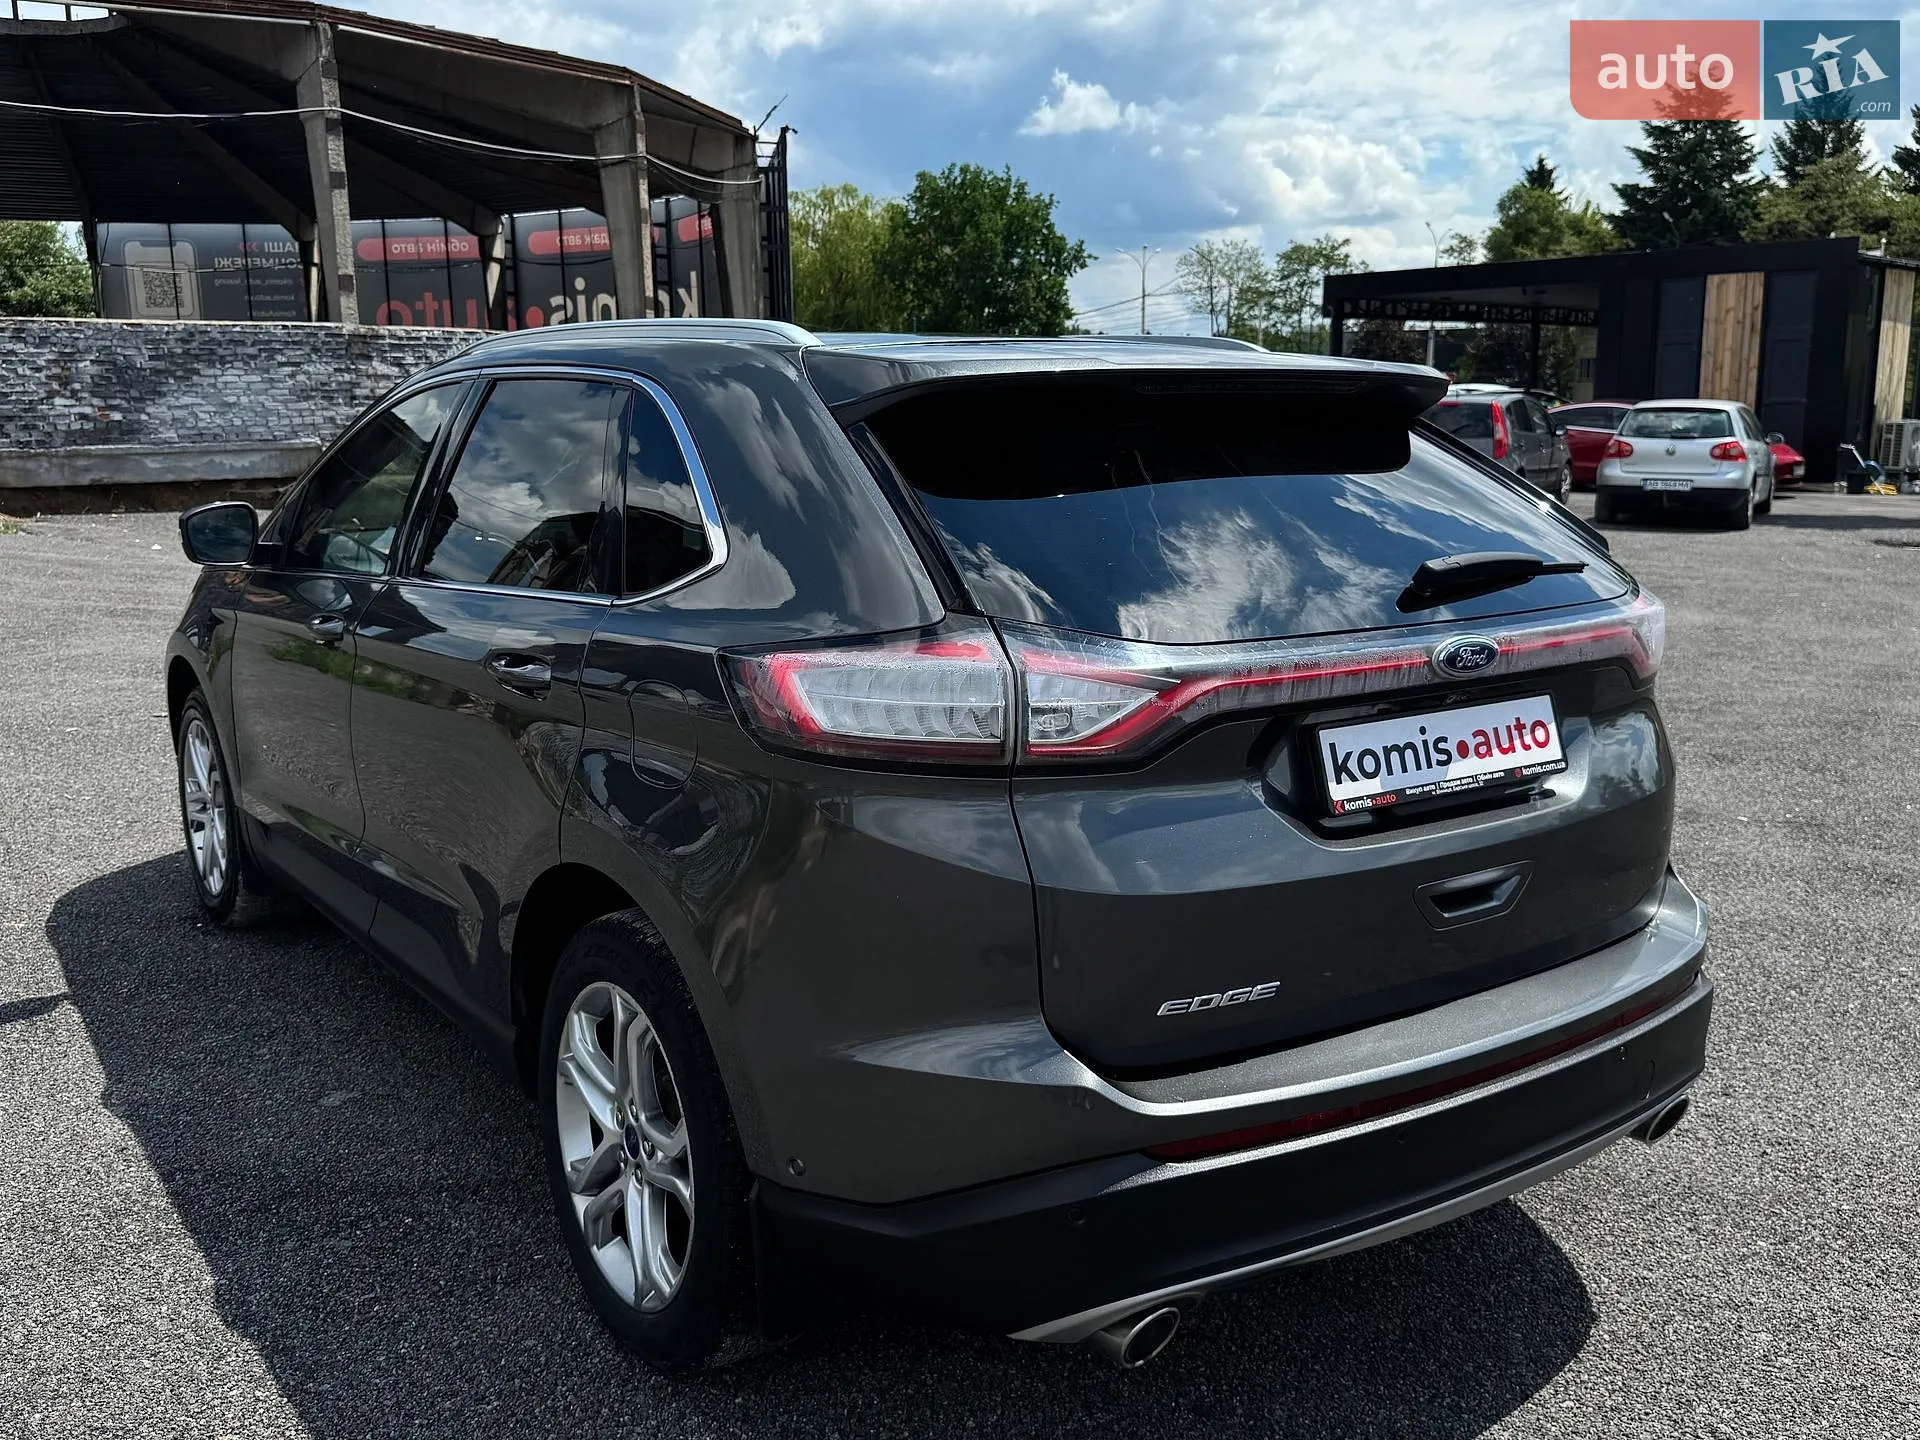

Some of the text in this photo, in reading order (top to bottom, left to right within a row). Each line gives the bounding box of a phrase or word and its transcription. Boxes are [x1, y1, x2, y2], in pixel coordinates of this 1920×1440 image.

[1456, 646, 1488, 668] Ford
[1521, 761, 1566, 775] komis.com.ua
[1156, 981, 1281, 1017] EDGE
